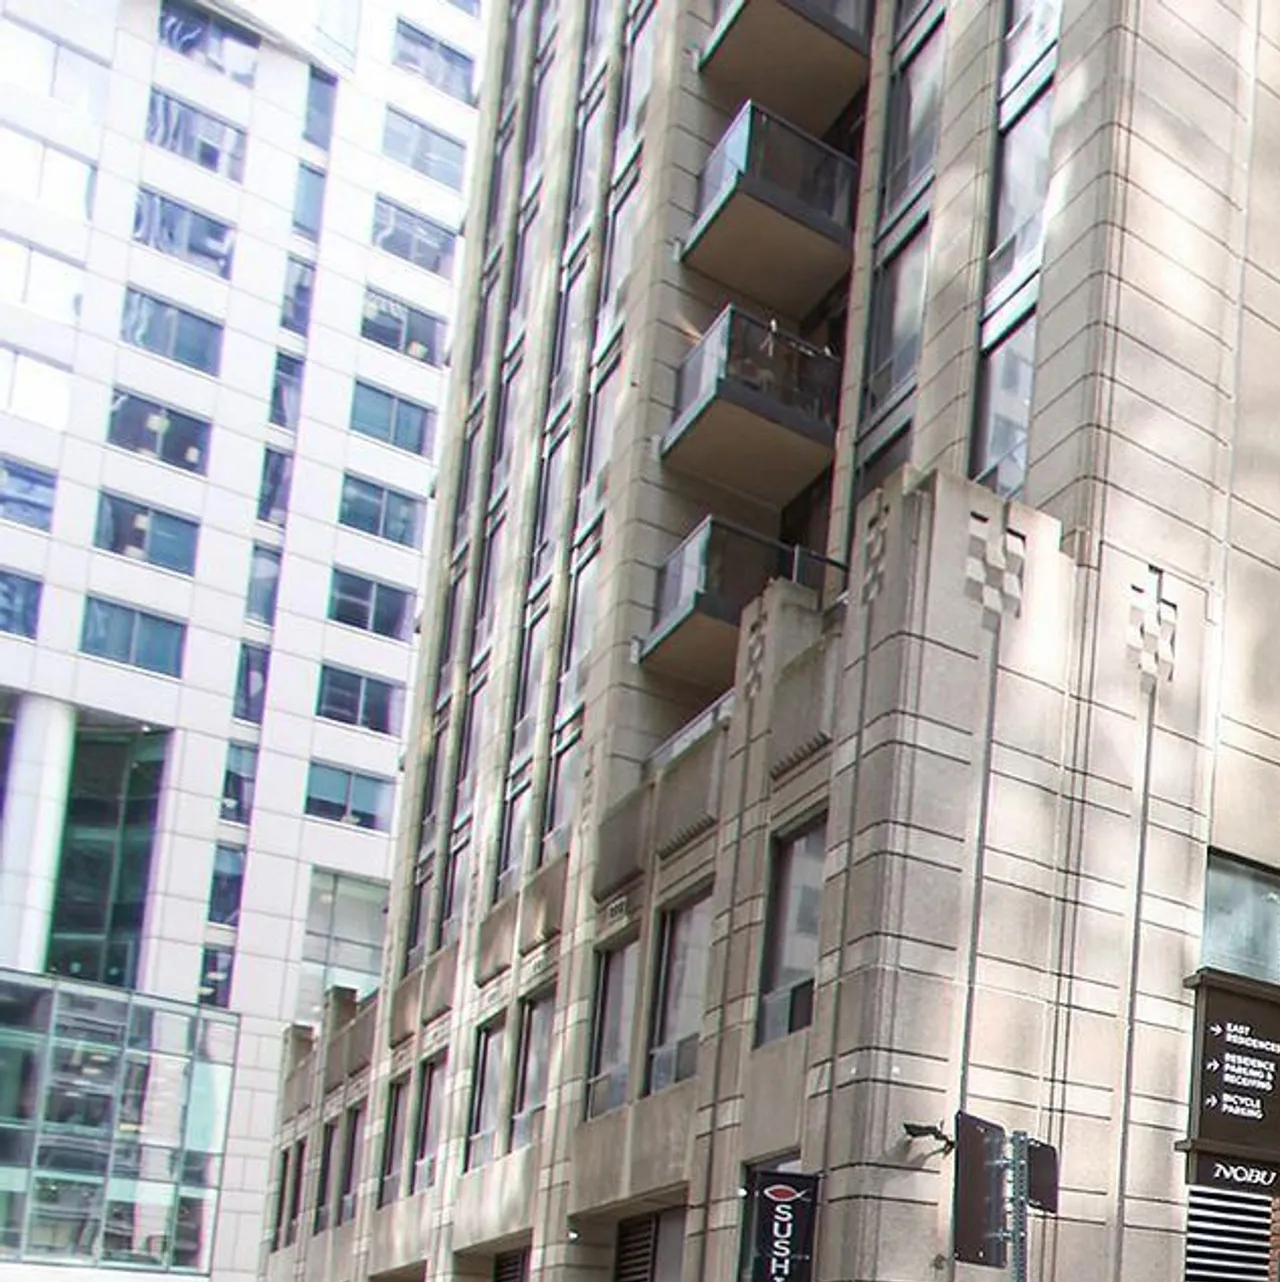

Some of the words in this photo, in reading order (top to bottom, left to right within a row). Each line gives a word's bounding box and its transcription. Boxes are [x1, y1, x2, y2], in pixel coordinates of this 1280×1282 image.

[1226, 1023, 1250, 1036] EAST
[1224, 1053, 1276, 1072] RESIDENCE
[1224, 1063, 1264, 1079] PARKING
[1223, 1073, 1273, 1091] RECEIVING
[1222, 1093, 1261, 1109] BICYCLE
[1221, 1104, 1264, 1119] PARKING
[1213, 1163, 1277, 1185] NOBU
